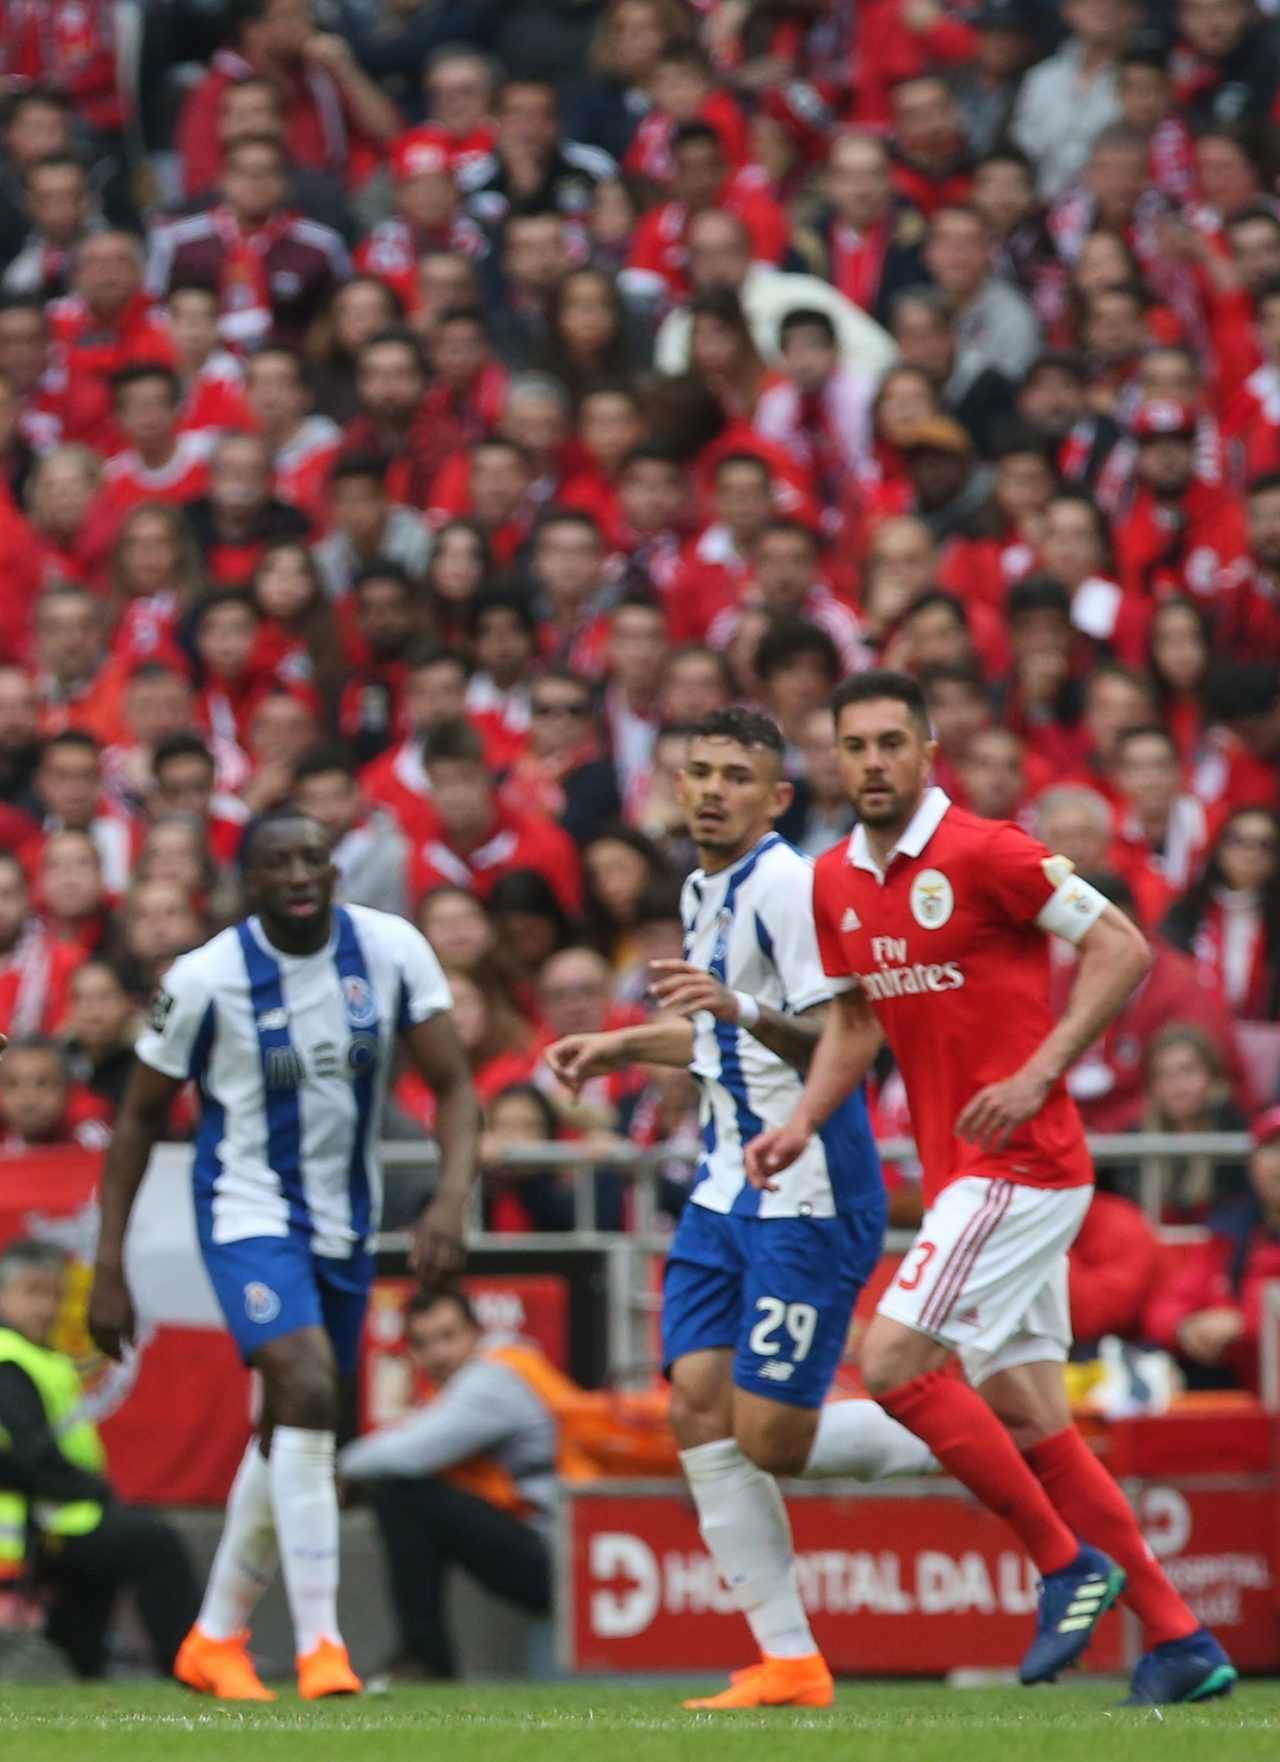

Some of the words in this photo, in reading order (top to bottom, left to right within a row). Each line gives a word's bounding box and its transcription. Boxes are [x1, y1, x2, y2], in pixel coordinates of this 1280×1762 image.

[870, 936, 908, 965] Fly
[852, 961, 965, 1002] mirates
[749, 1296, 818, 1362] 29
[916, 1550, 998, 1614] DA
